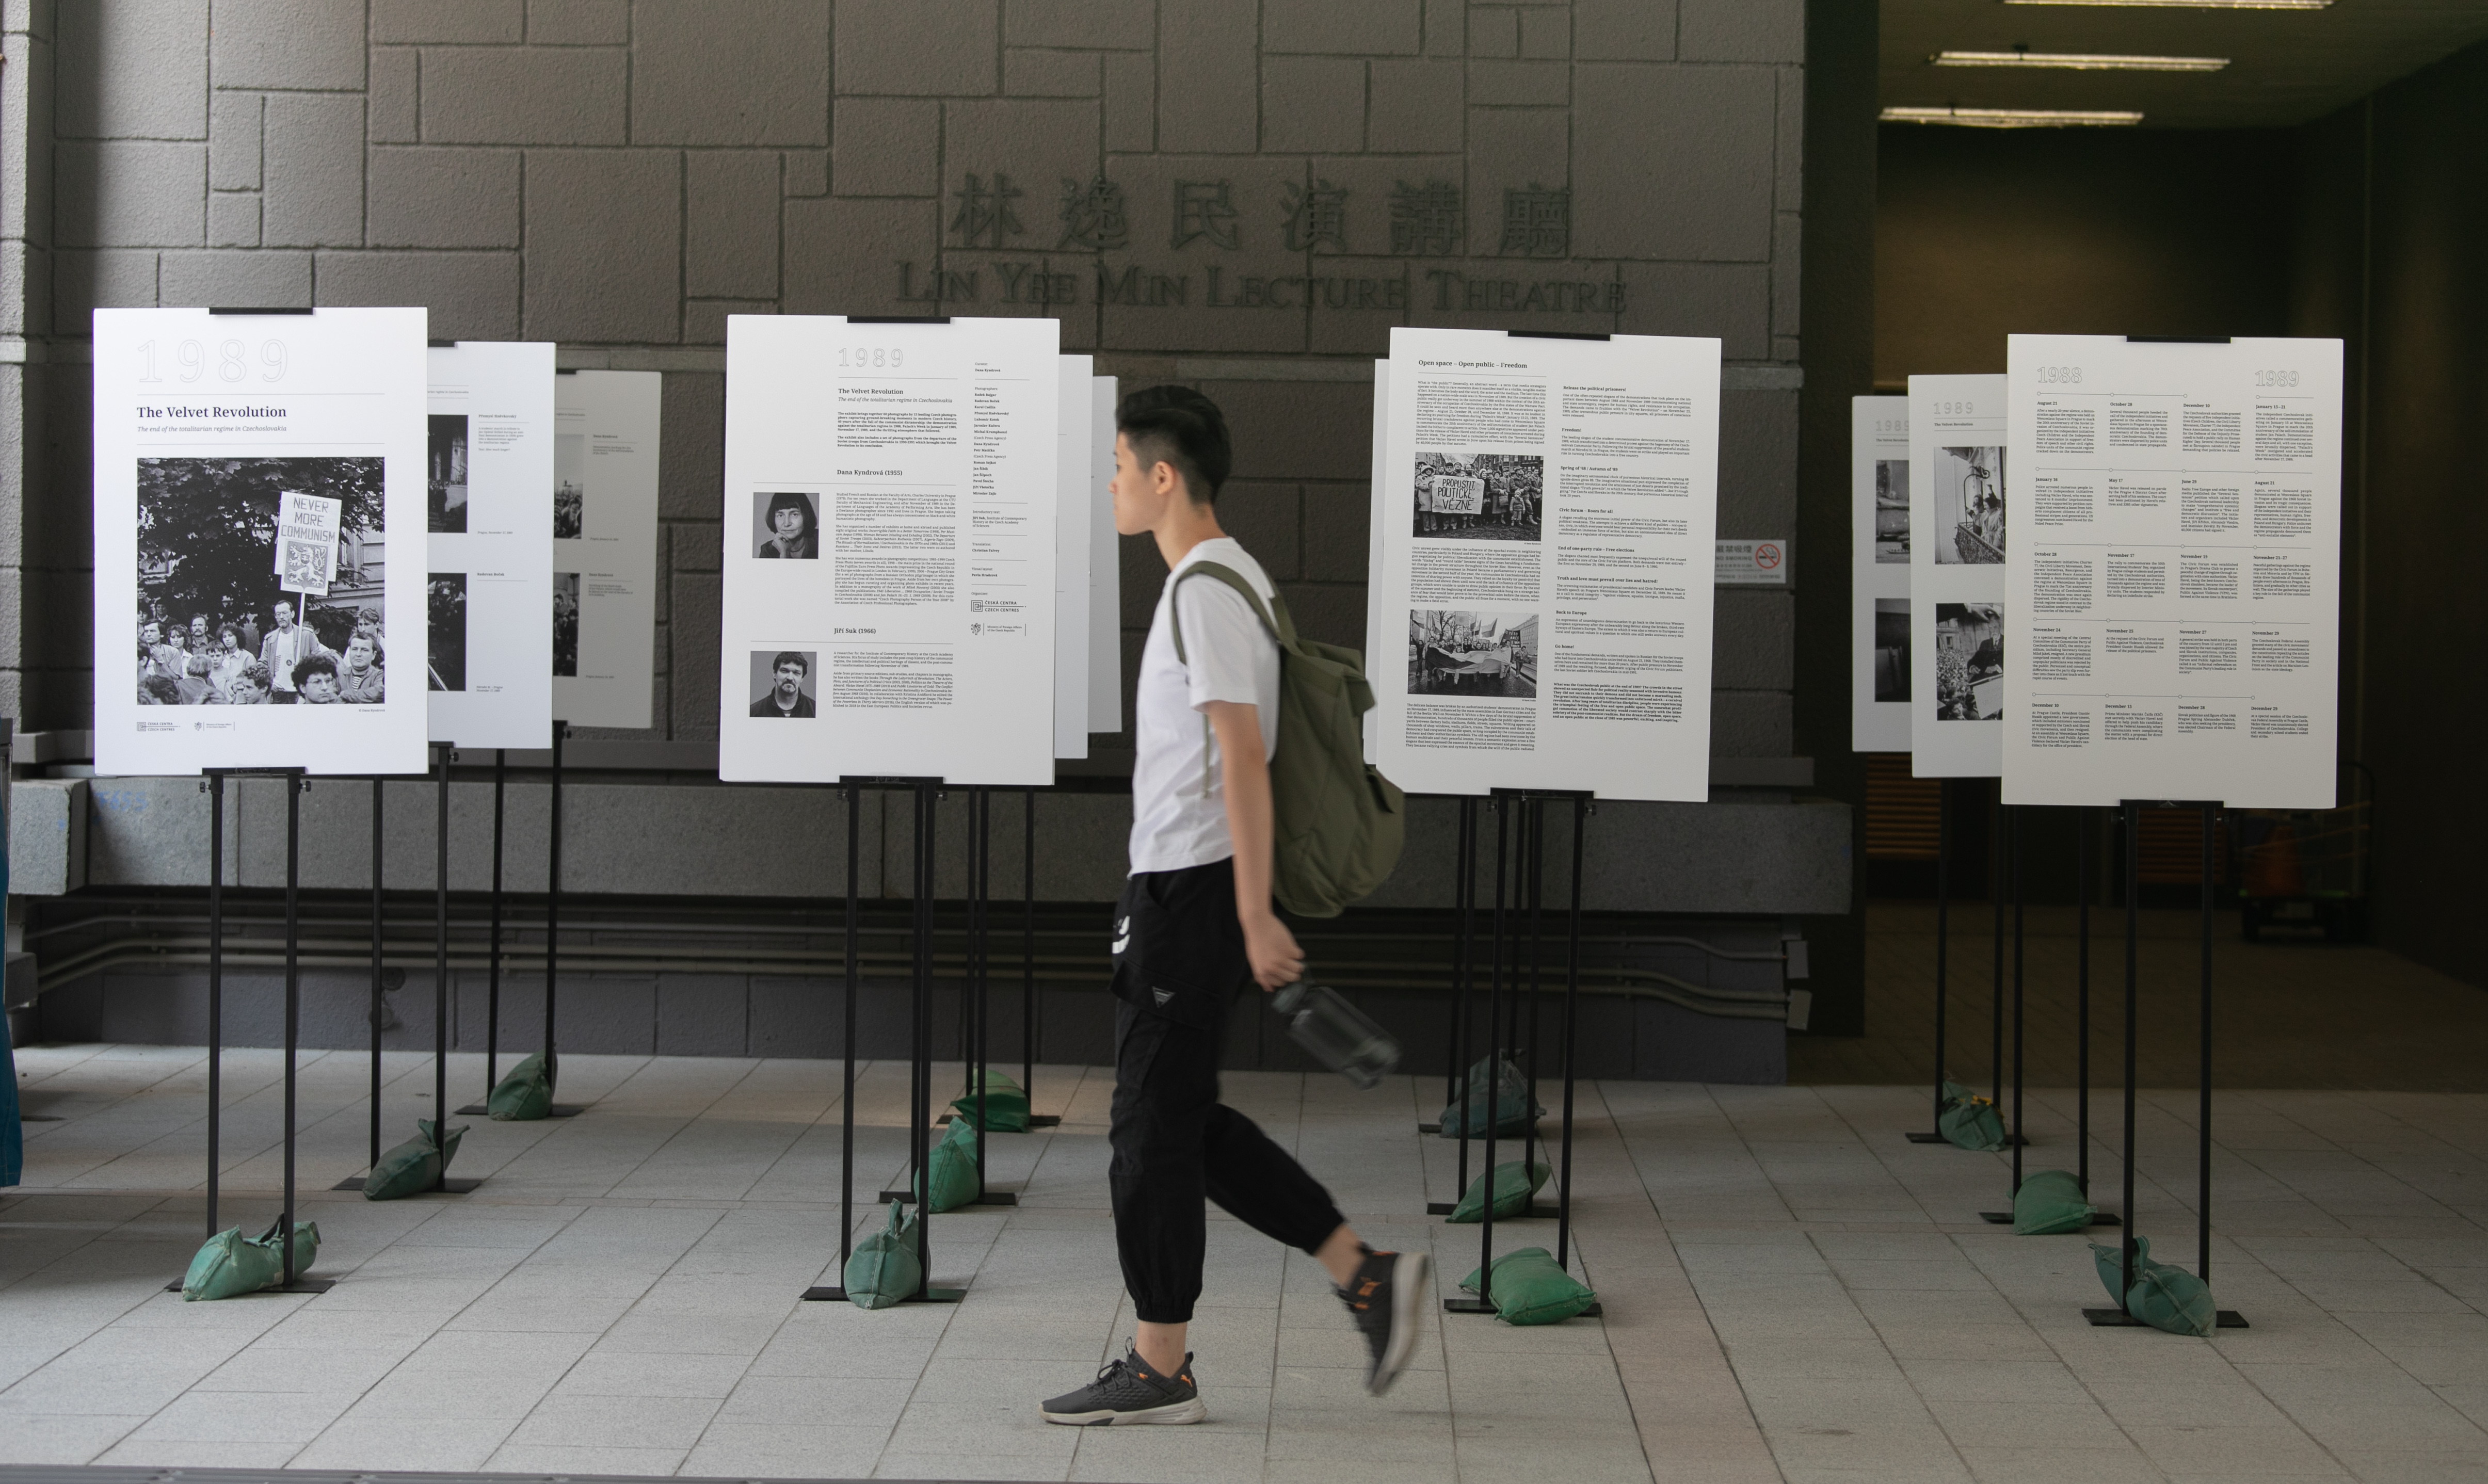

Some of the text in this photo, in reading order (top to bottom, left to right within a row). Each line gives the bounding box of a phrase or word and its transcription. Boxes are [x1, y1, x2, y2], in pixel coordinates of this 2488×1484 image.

[950, 171, 1570, 254] 林逸民演講廳
[895, 261, 1627, 314] LIN YEE MIN LECTURE THEATRE
[138, 339, 288, 382] 1989
[839, 348, 903, 367] 1989
[2037, 367, 2082, 383] 1988
[2255, 370, 2299, 387] 1989
[136, 406, 286, 417] The Velvet Revolution
[1933, 402, 1973, 414] 1989
[1442, 479, 1476, 489] PROPUSTIT
[1437, 487, 1475, 499] POLITICKÉ
[293, 497, 329, 513] NEVER
[1442, 497, 1474, 511] VĚZNĚ
[295, 512, 325, 528] MORE
[281, 525, 336, 543] COMMUNISM
